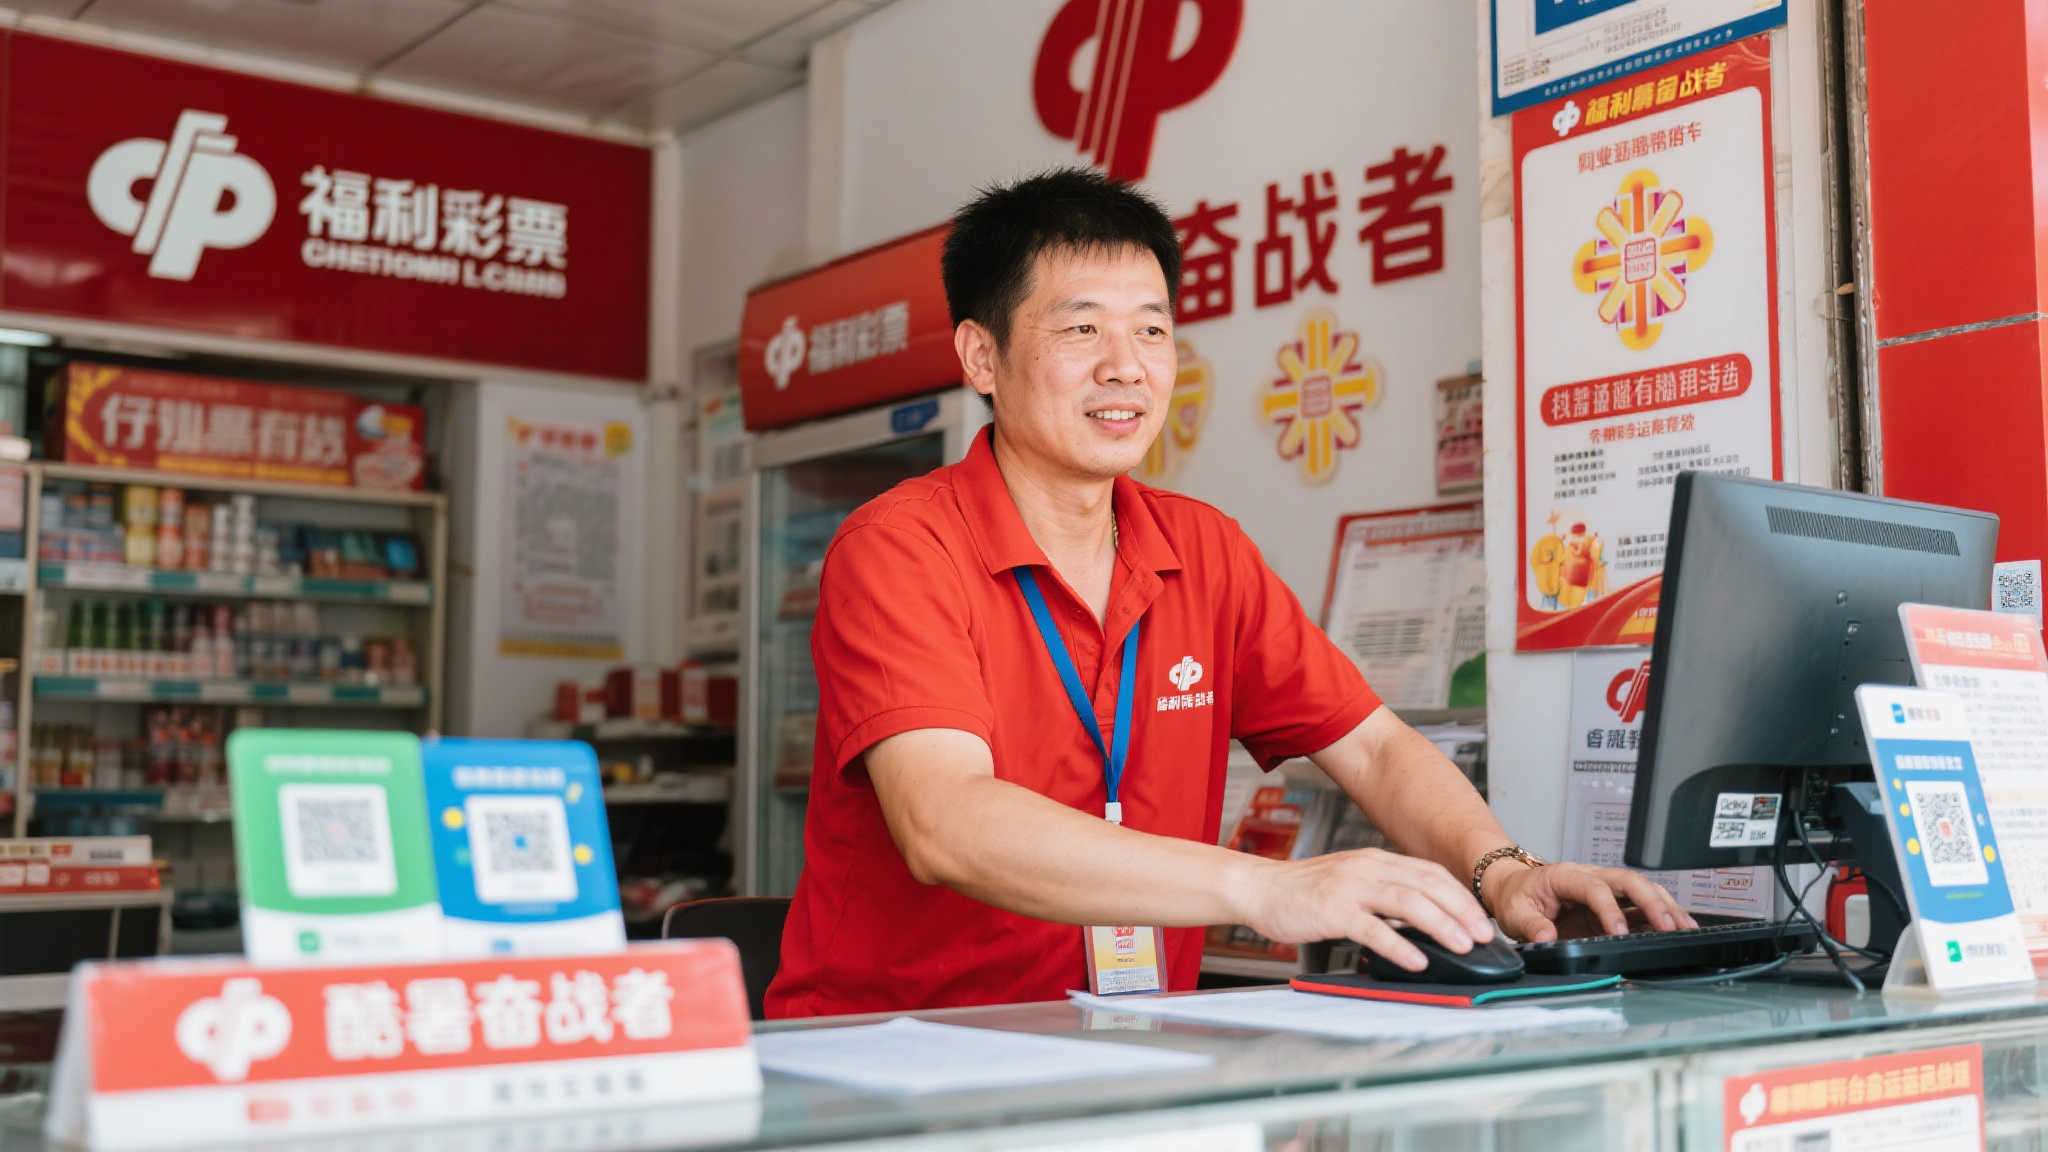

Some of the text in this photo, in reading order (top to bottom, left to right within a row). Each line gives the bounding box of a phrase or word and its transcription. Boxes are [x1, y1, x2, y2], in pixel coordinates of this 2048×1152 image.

[299, 164, 569, 270] 福利彩票
[322, 966, 675, 1061] 酷暑奋战者
